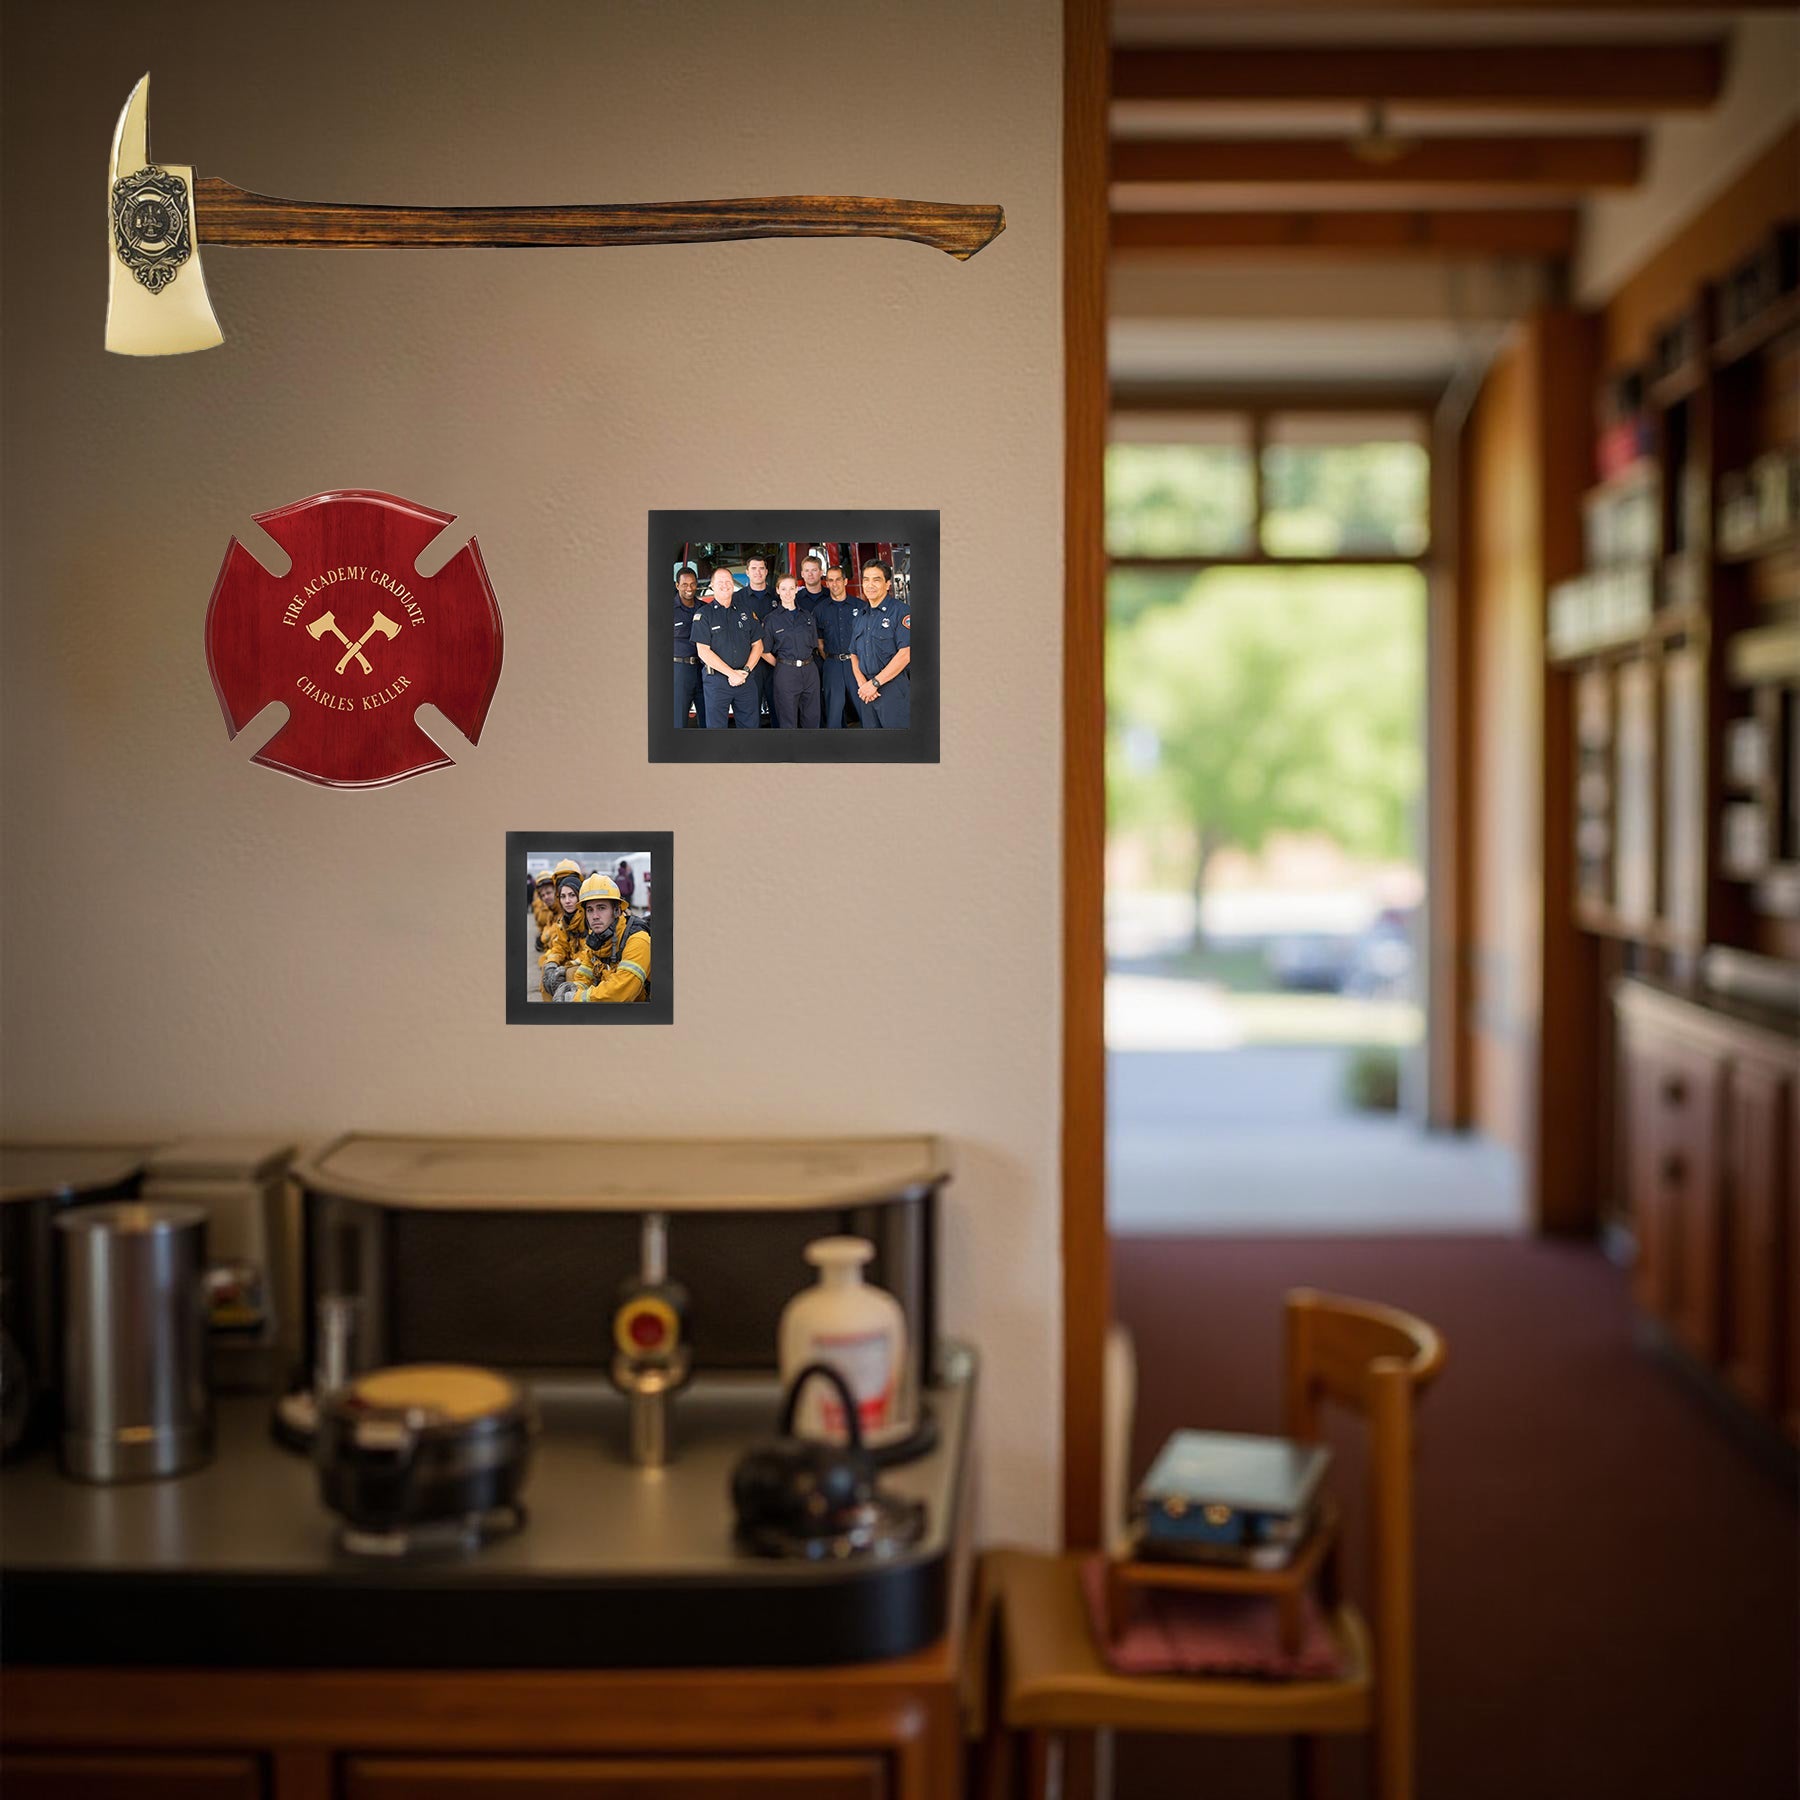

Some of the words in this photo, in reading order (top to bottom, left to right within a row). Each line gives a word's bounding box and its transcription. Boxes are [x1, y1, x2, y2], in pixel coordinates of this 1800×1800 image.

[282, 595, 307, 626] FIRE
[303, 566, 368, 598] ACADEMY
[370, 569, 426, 627] GRADUATE
[296, 676, 354, 712] CHARLES
[362, 675, 412, 710] KELLER
